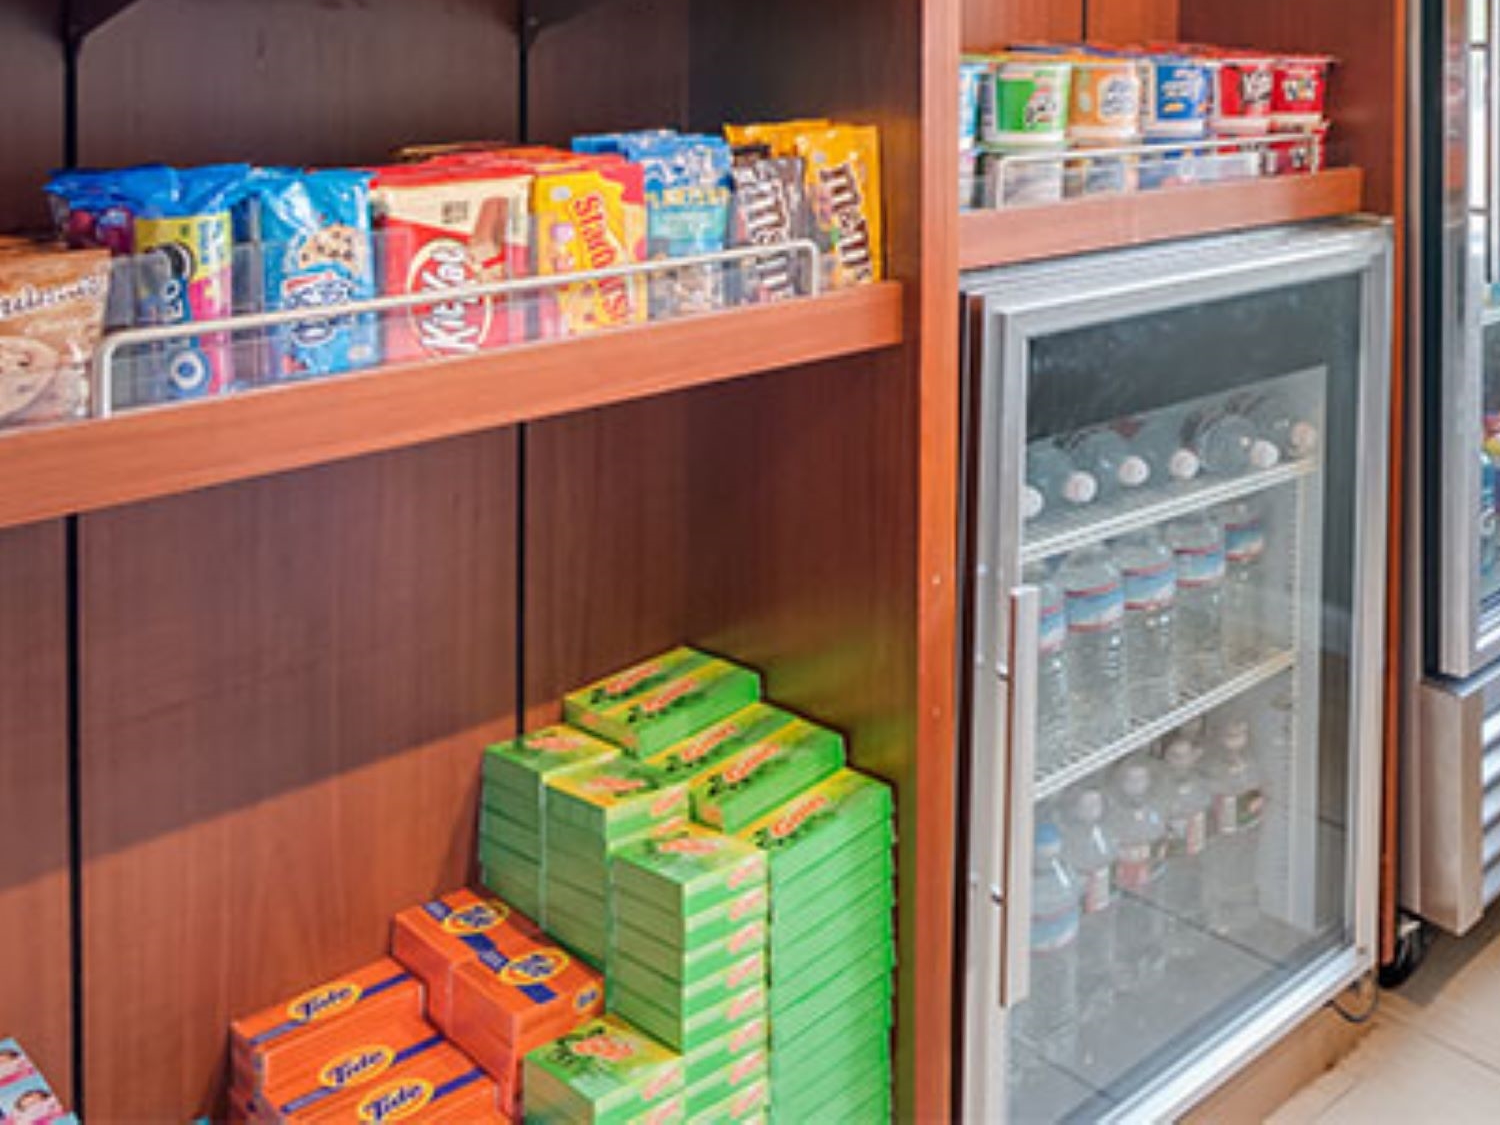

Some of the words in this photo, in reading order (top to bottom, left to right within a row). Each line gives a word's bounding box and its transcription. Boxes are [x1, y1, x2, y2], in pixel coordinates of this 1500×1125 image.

[575, 195, 629, 320] Starbrst
[294, 986, 352, 1020] Tide
[324, 1050, 384, 1085] Tide
[361, 1083, 424, 1122] Tide
